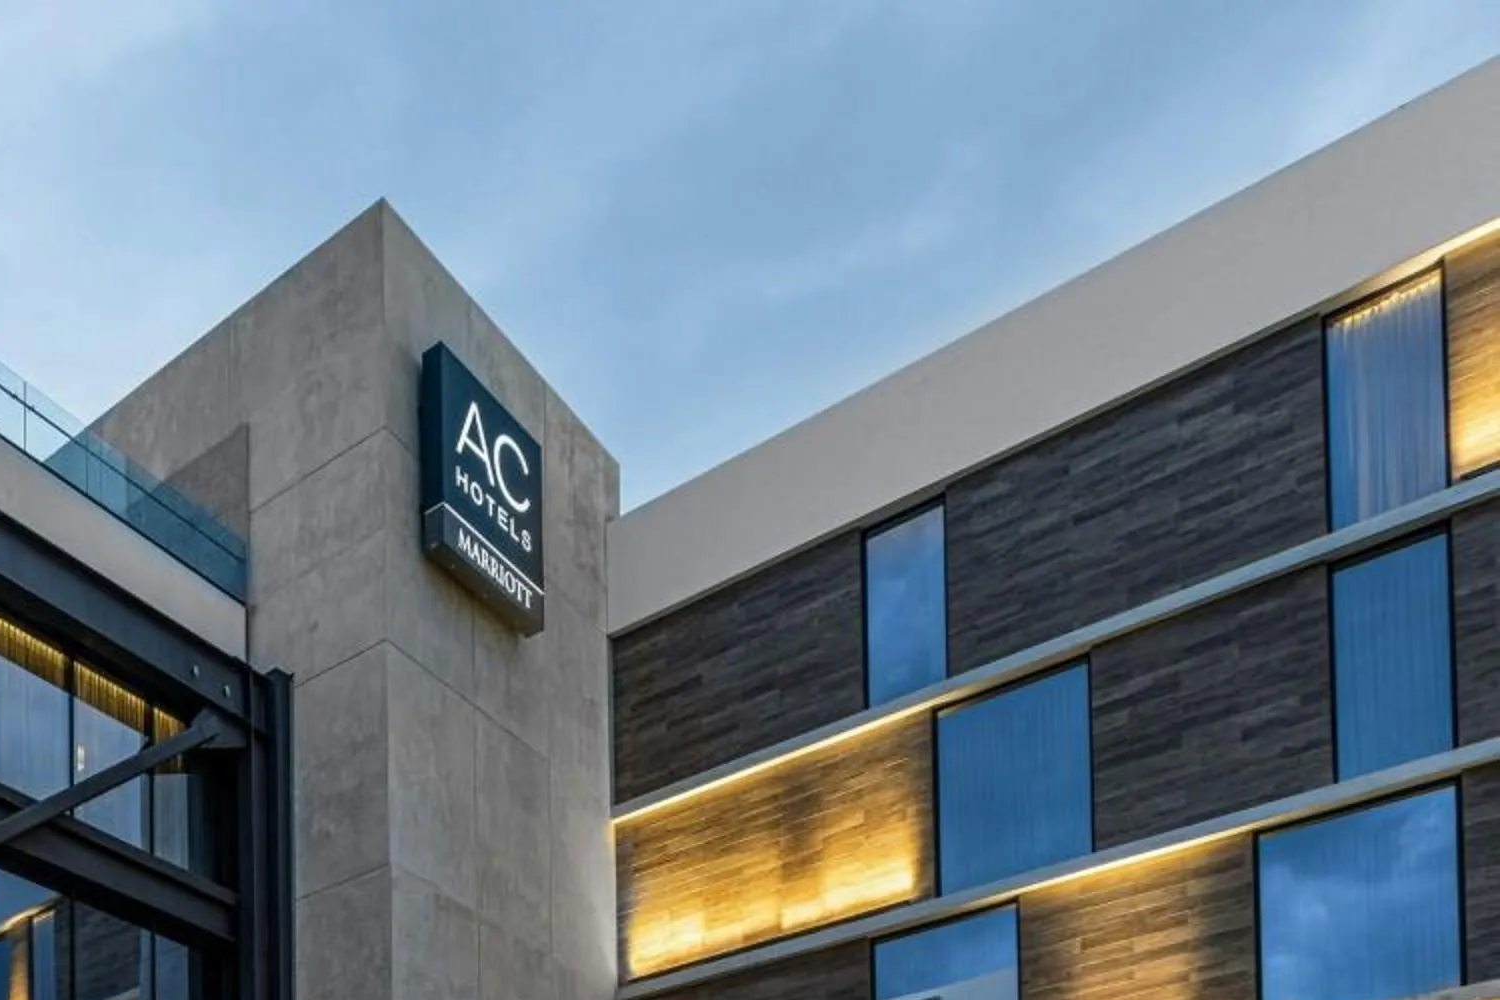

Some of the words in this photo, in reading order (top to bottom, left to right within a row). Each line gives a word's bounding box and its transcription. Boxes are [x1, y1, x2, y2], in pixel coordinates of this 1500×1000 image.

[455, 401, 531, 513] AC
[455, 466, 532, 553] HOTELS
[457, 527, 534, 609] MARRIOTT
